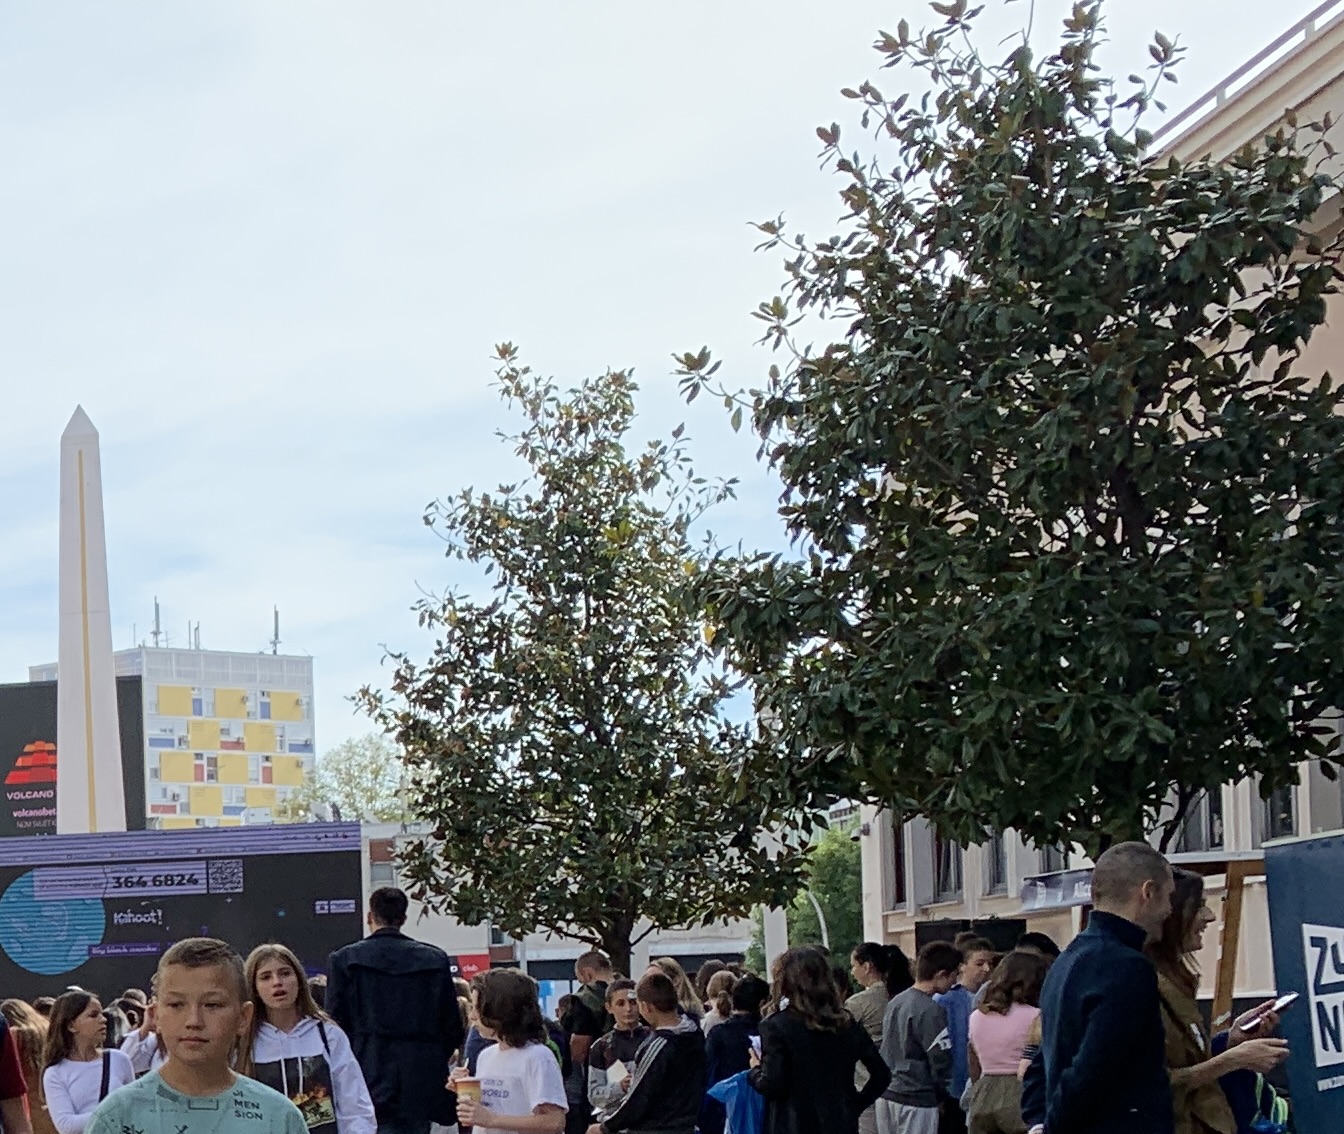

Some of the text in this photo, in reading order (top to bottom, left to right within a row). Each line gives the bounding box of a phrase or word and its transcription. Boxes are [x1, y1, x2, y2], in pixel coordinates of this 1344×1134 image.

[6, 789, 54, 801] VOLCANO
[112, 875, 148, 889] 364
[152, 873, 200, 888] 6824
[113, 908, 163, 926] Kahoot!
[234, 1099, 260, 1110] MEN
[234, 1110, 263, 1120] SION
